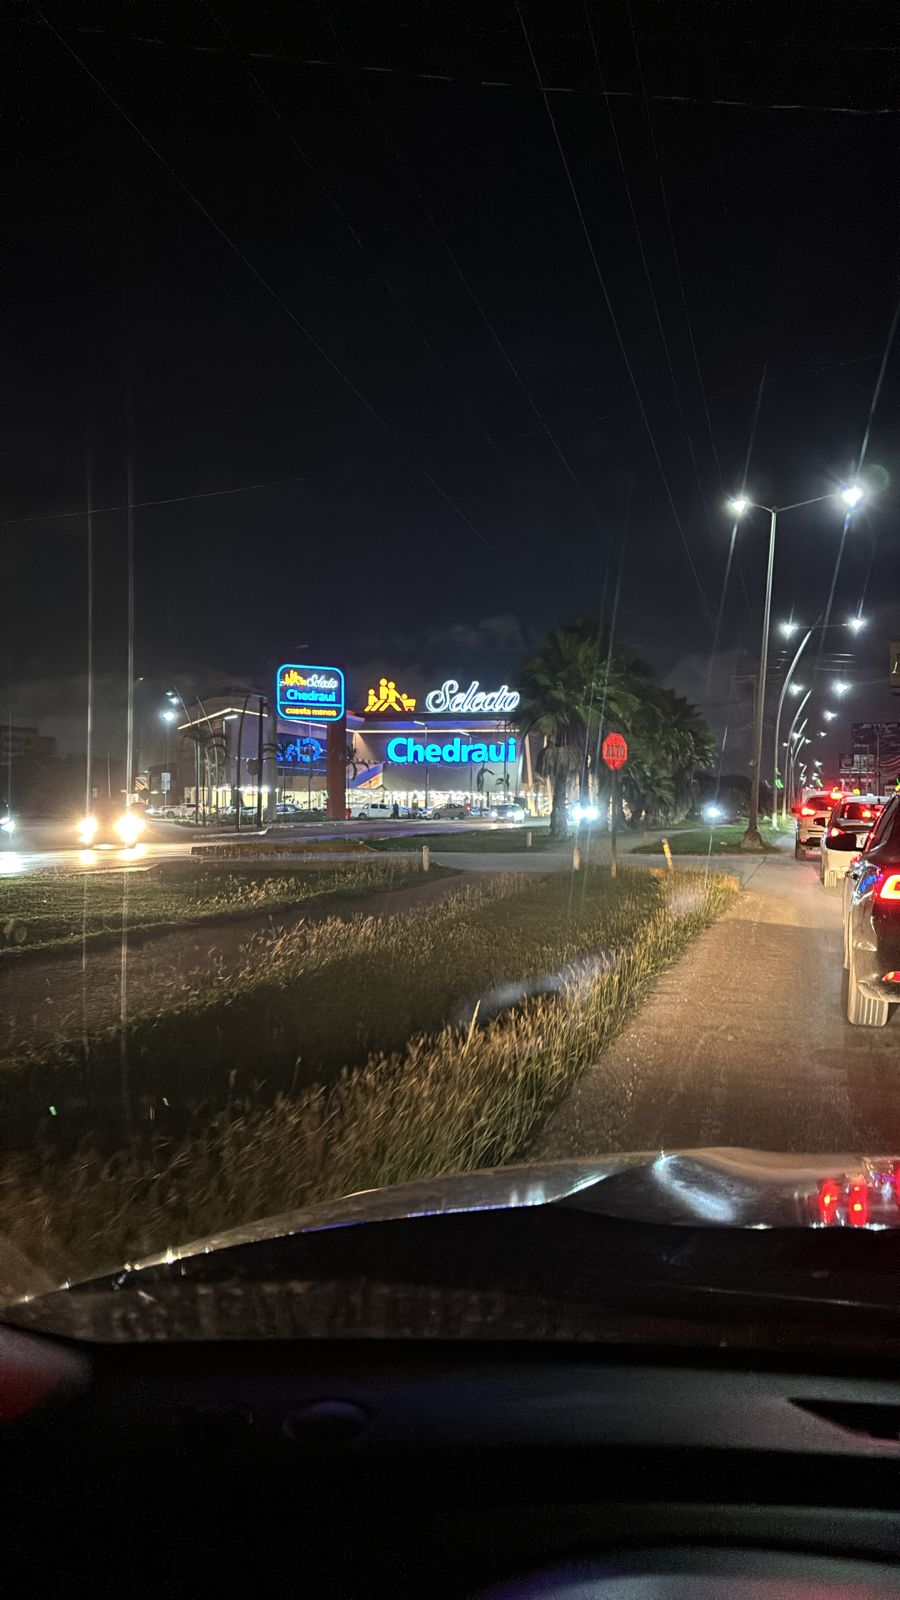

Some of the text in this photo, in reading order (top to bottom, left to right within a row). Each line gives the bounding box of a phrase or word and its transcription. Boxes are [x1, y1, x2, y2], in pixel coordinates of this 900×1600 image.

[286, 688, 336, 702] Chedraui
[425, 679, 520, 712] Selecto
[285, 707, 337, 717] cuesta menos
[387, 737, 516, 762] Chedraui
[606, 744, 625, 757] ALTO
